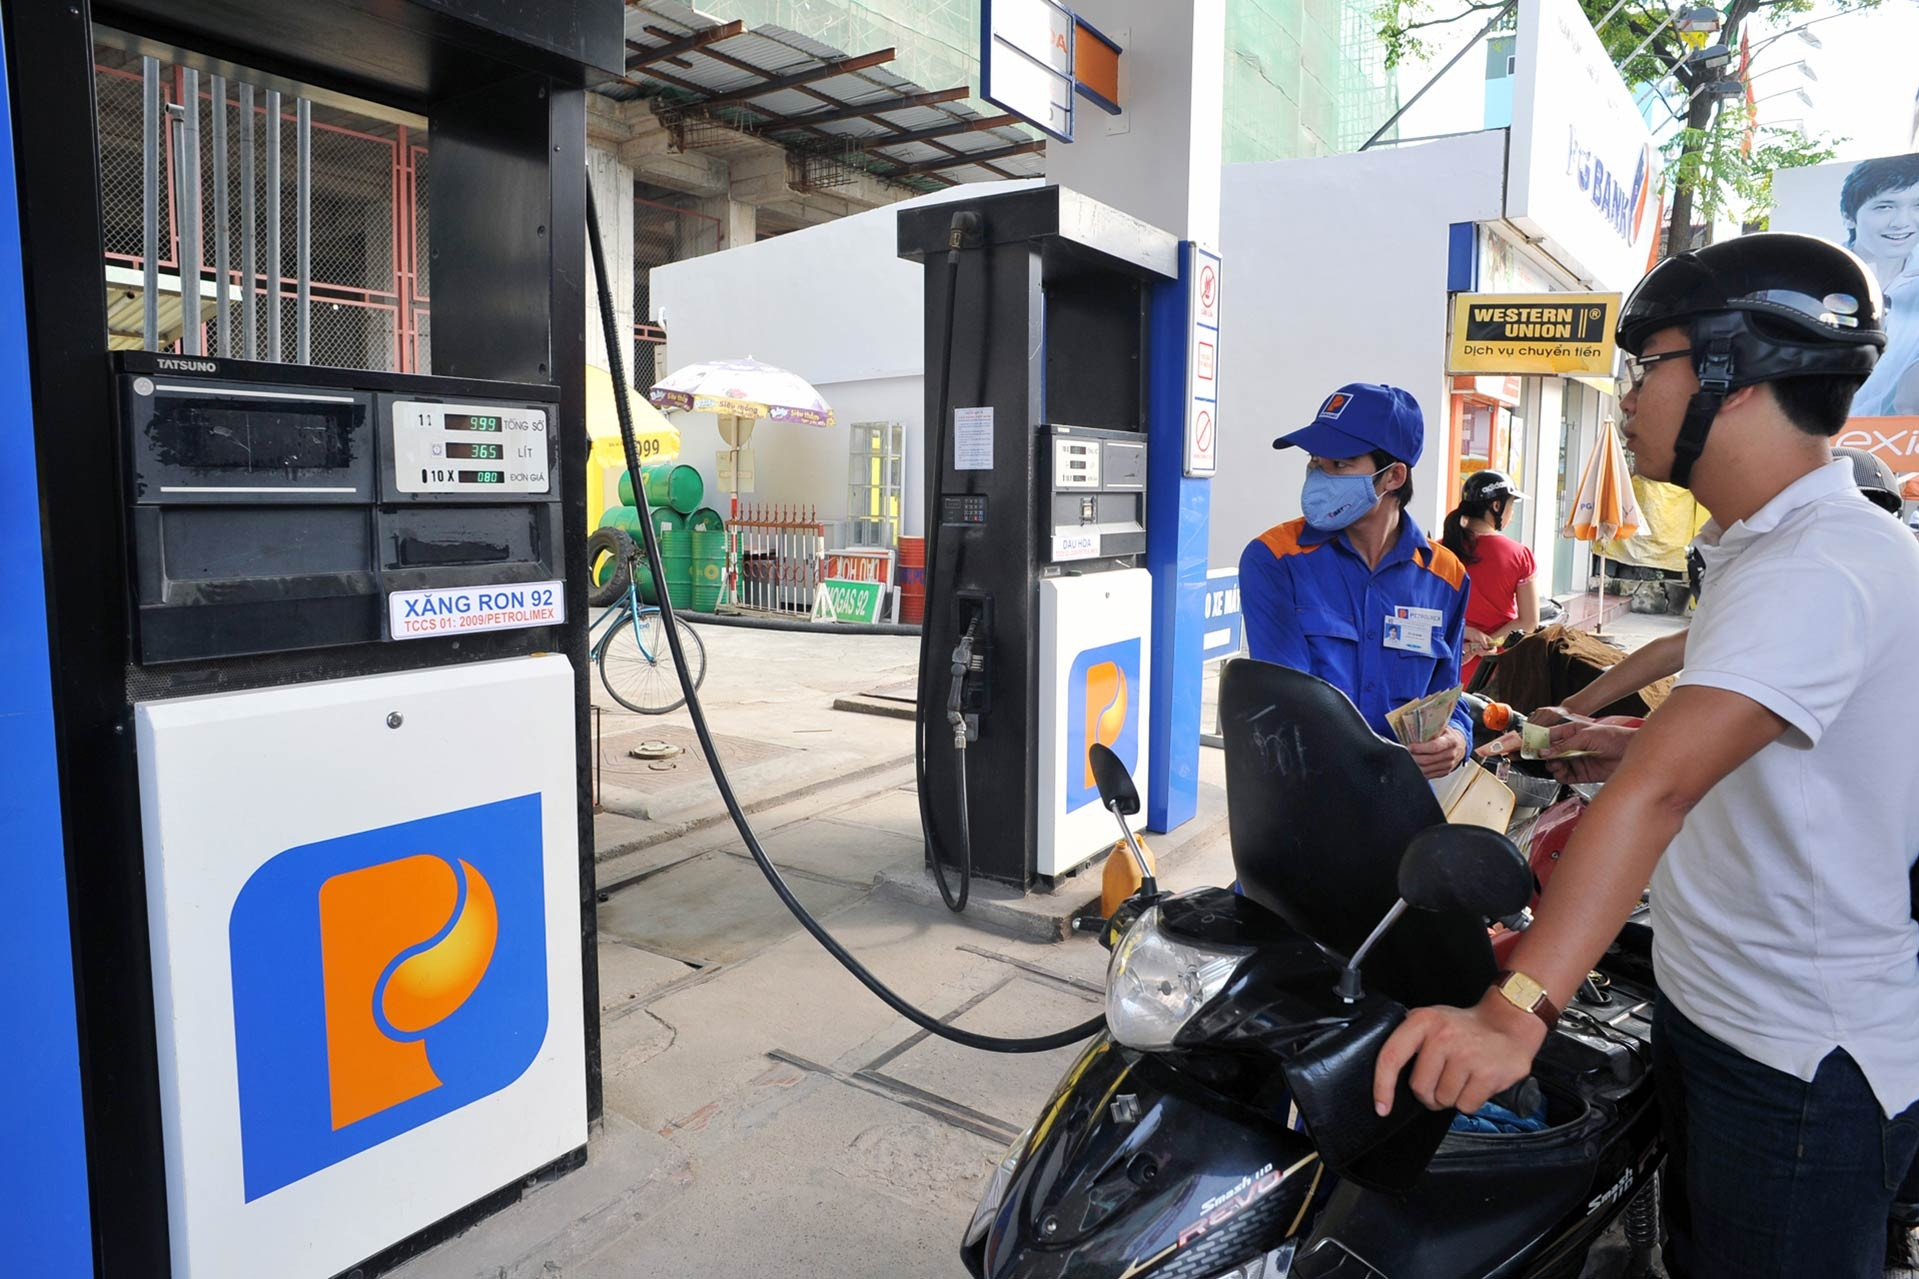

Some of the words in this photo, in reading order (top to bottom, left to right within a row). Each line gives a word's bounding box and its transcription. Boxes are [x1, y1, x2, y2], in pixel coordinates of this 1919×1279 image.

[1591, 157, 1630, 240] BANK
[1474, 308, 1573, 322] WESTERN
[1505, 323, 1571, 338] UNION
[1464, 344, 1494, 357] Dịch
[1498, 347, 1514, 358] vụ
[1518, 344, 1571, 358] chuyển
[156, 358, 217, 373] TATSUNO
[470, 416, 496, 431] 999
[471, 444, 497, 459] 365
[517, 445, 533, 458] LÍT
[404, 593, 471, 618] XĂNG
[479, 591, 524, 612] RON
[531, 589, 553, 607] 92
[855, 589, 869, 616] 92
[404, 618, 437, 633] TCCS
[440, 617, 457, 629] 01:
[460, 607, 554, 628] 2009/PETROLIMEX
[1200, 1176, 1252, 1217] Smash
[1586, 1167, 1633, 1216] Smash
